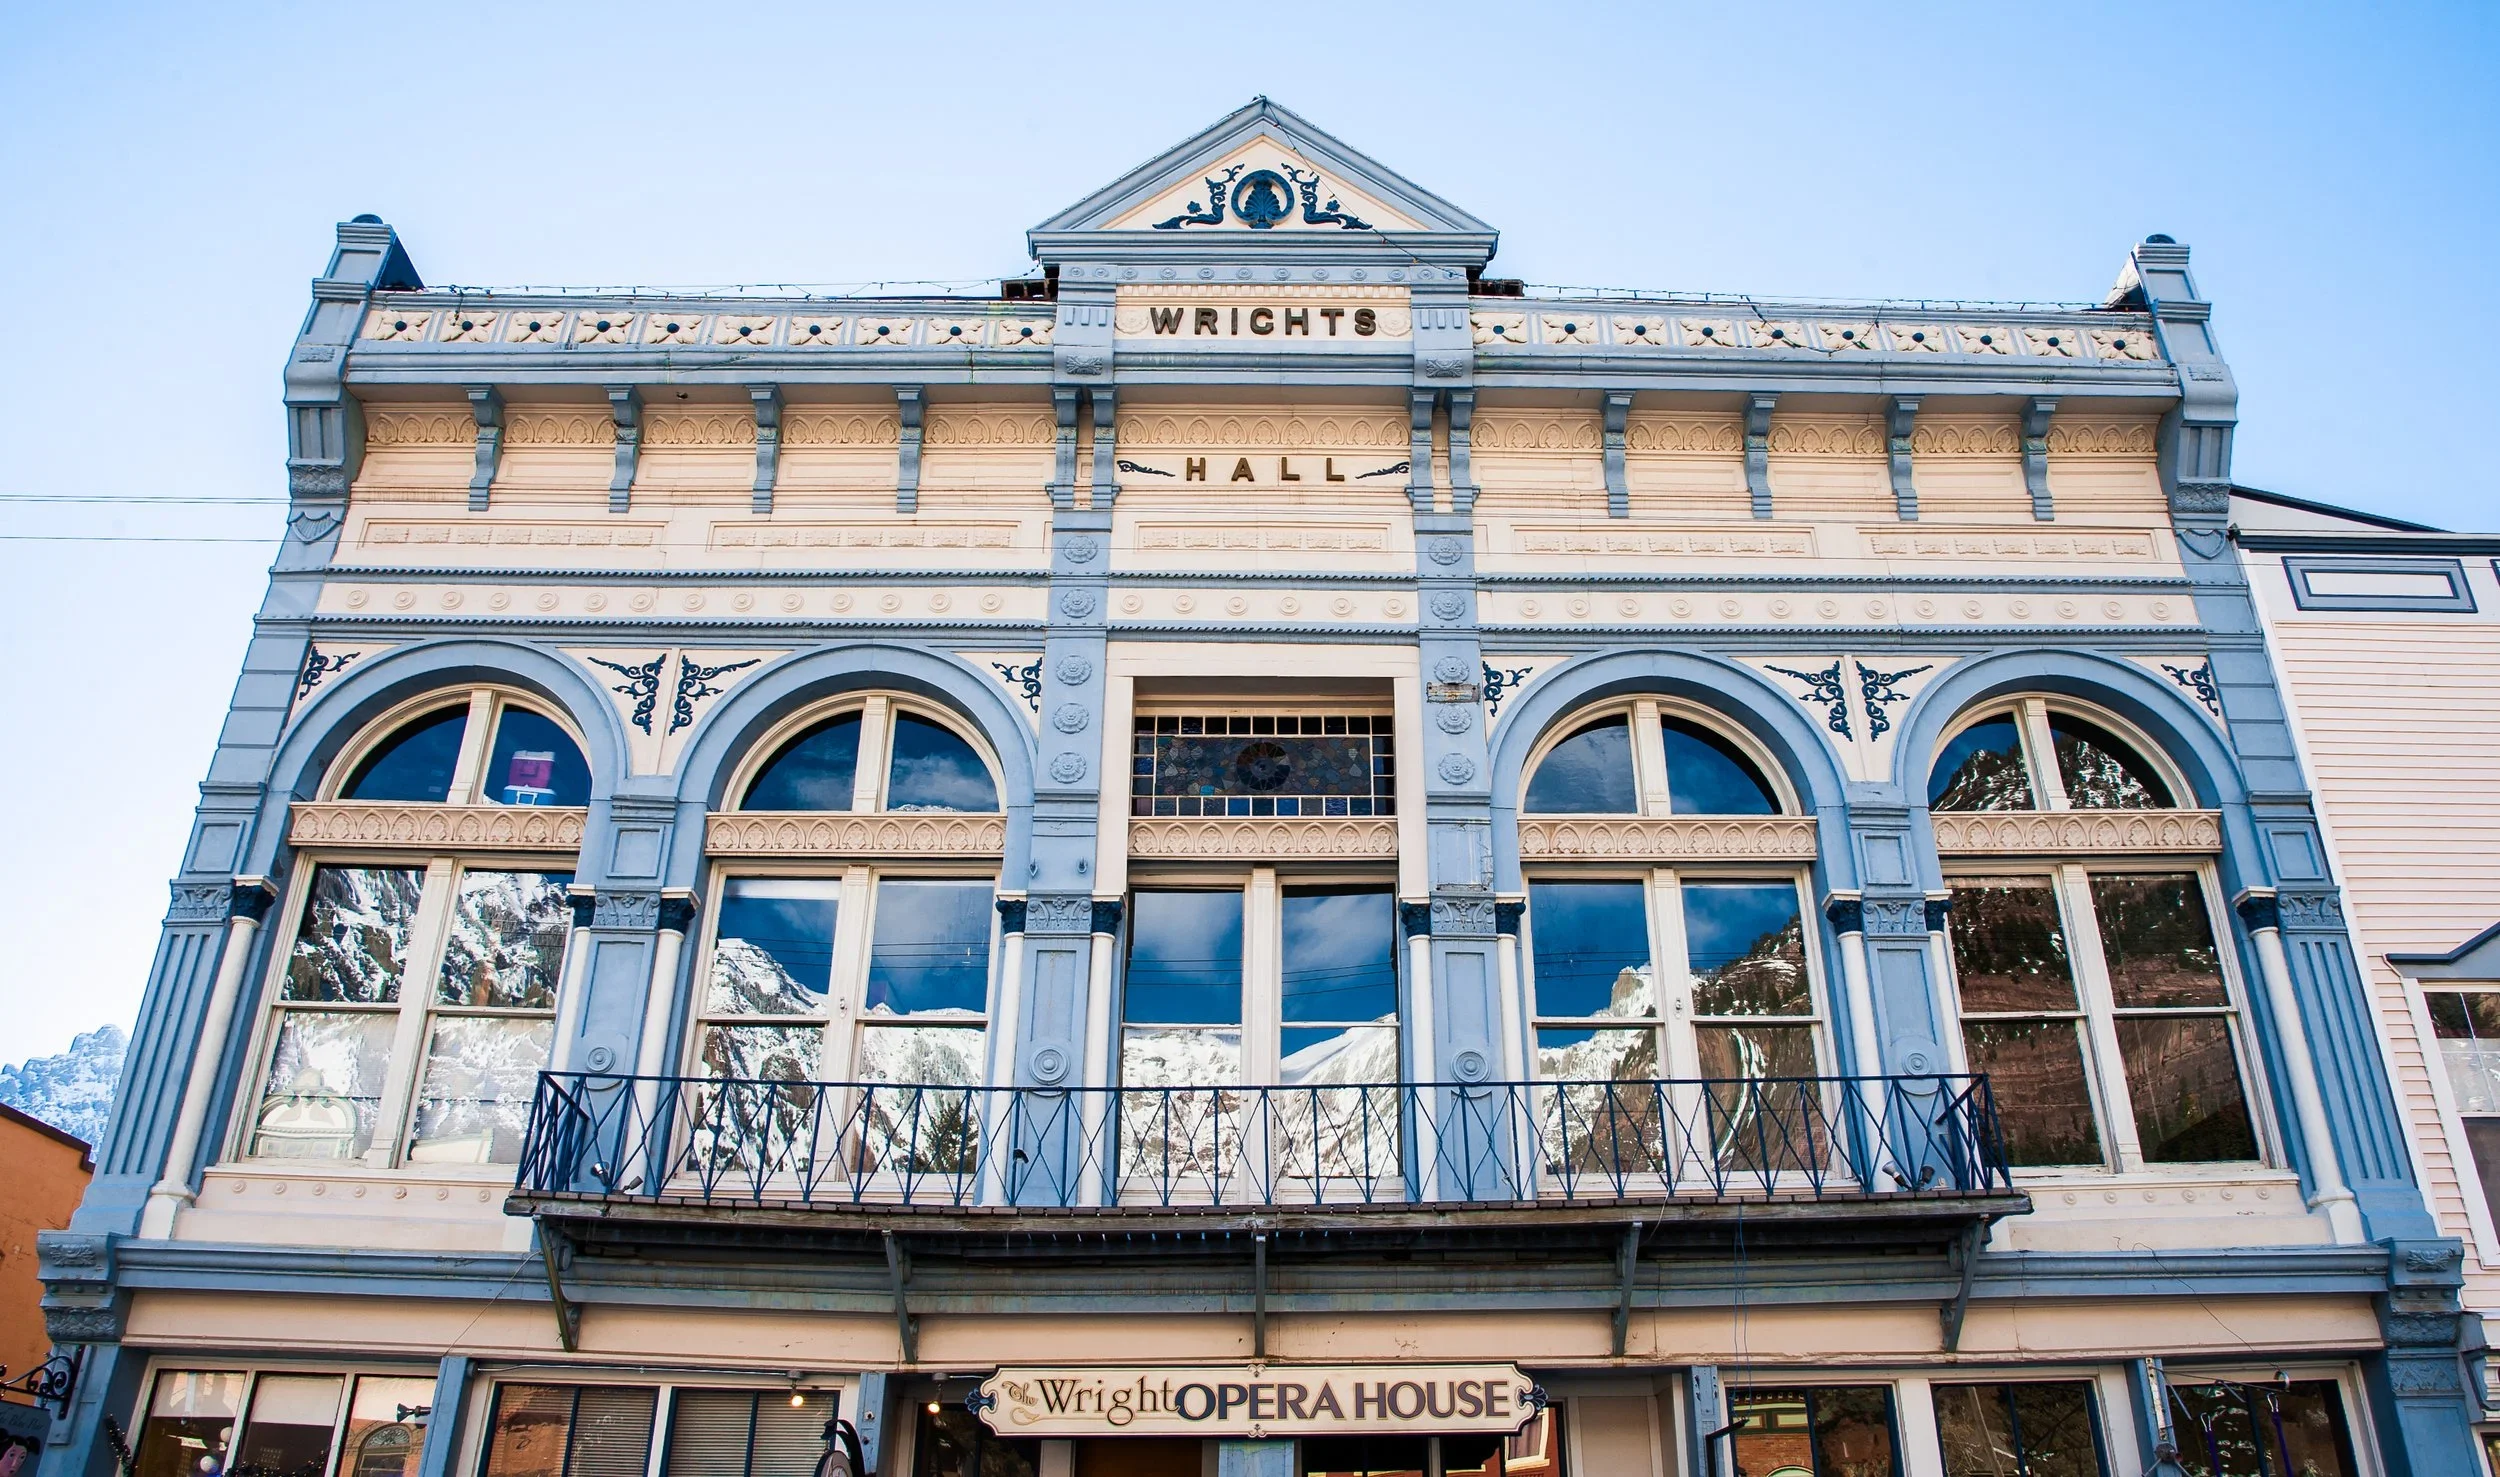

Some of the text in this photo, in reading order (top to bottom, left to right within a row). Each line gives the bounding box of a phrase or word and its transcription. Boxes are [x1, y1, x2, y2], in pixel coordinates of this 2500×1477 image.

[1150, 307, 1377, 336] WRIGHTS
[1186, 456, 1345, 482] HALL
[1001, 1375, 1510, 1426] The Wright OPERA HOUSE
